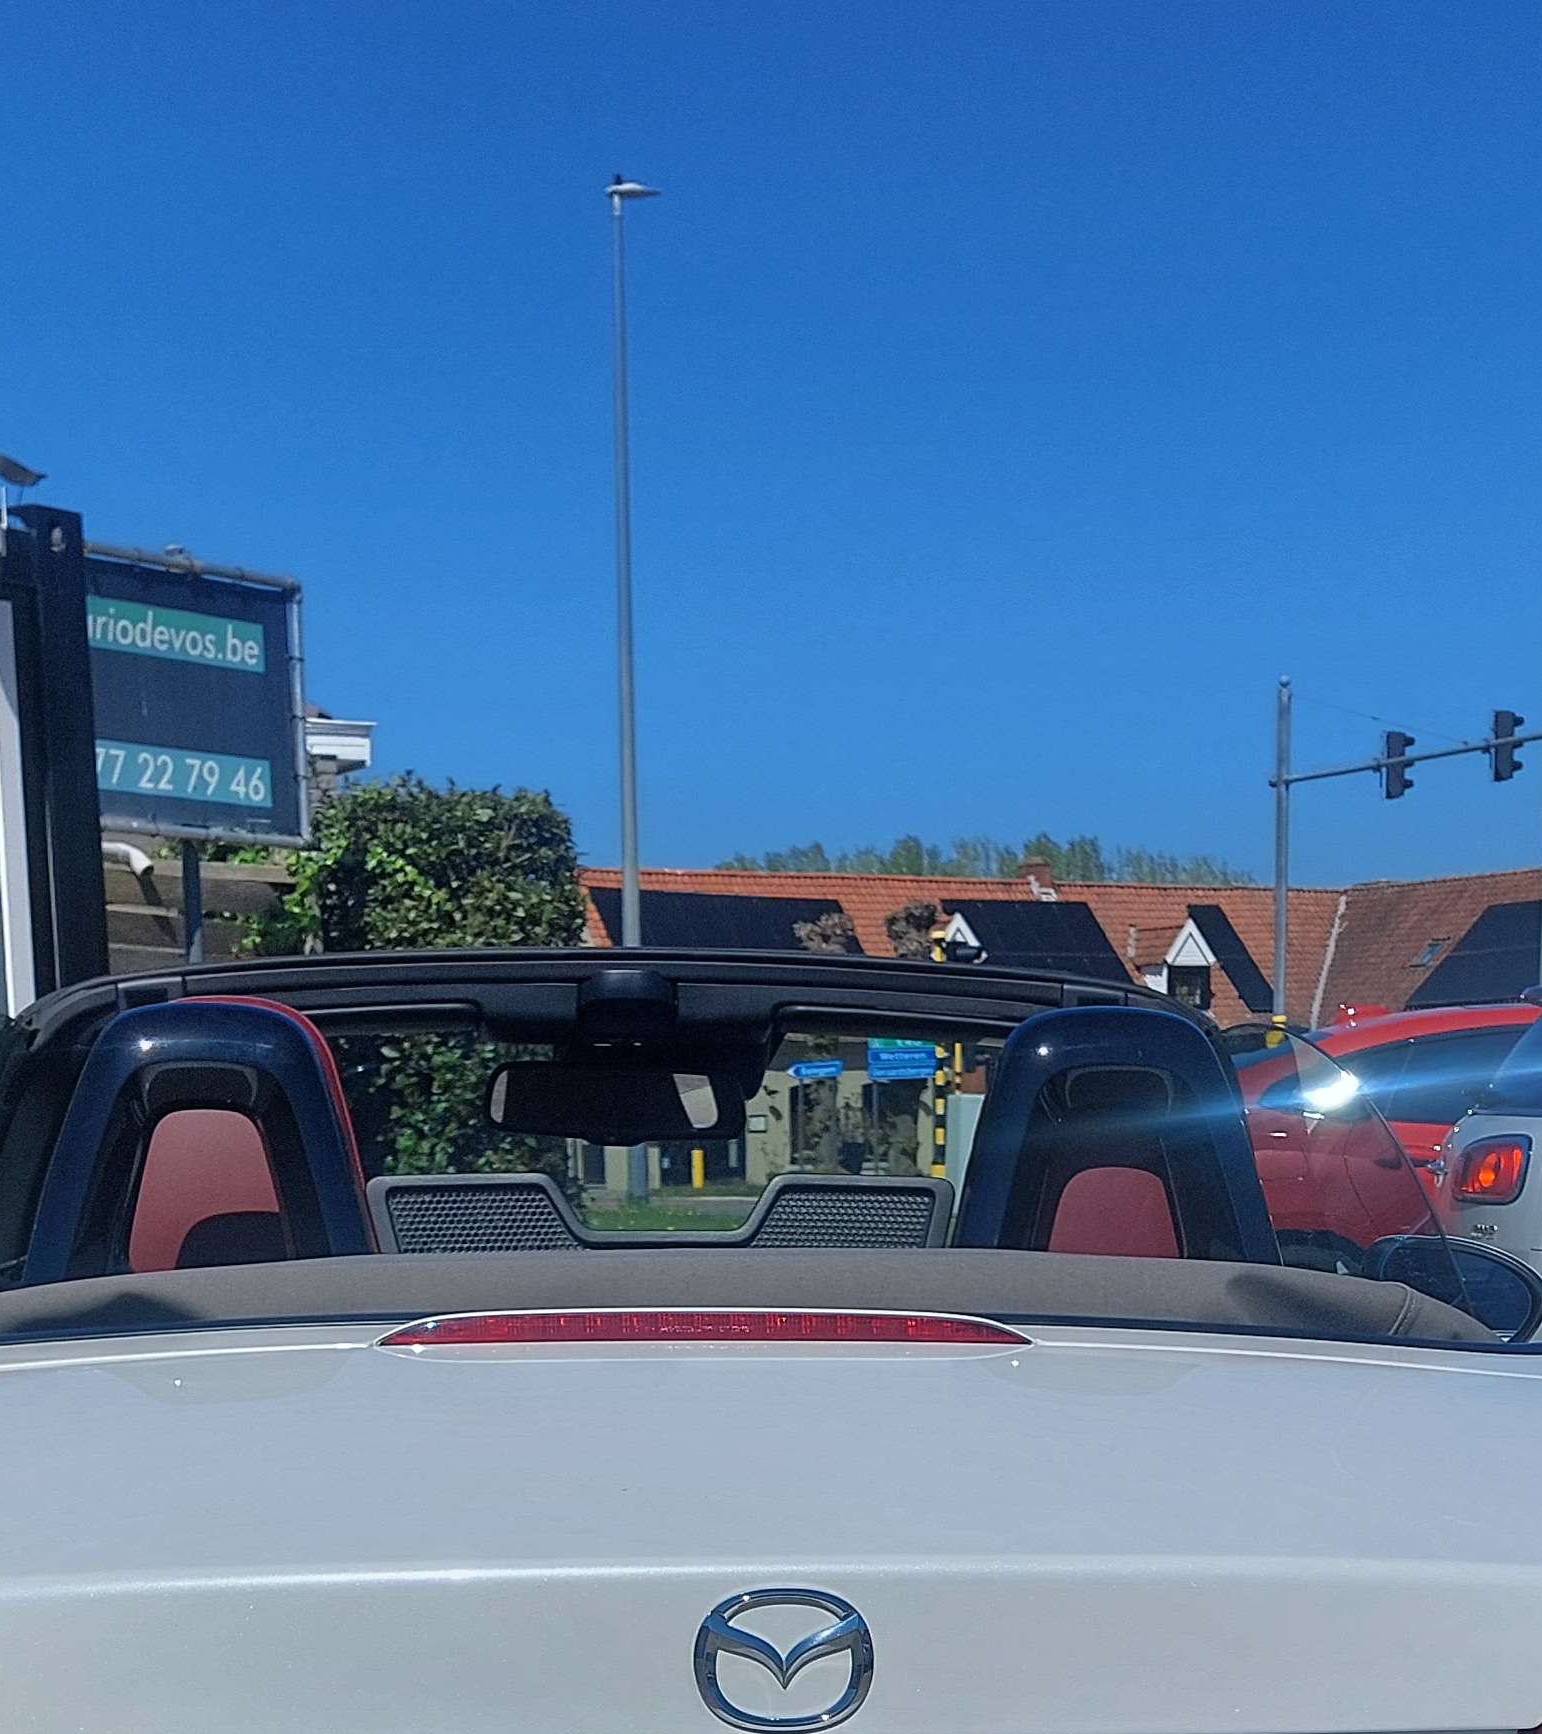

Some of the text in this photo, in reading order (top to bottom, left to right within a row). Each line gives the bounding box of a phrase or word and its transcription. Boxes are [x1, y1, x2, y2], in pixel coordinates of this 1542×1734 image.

[137, 752, 174, 791] 22
[185, 757, 220, 796] 79
[229, 765, 266, 801] 46
